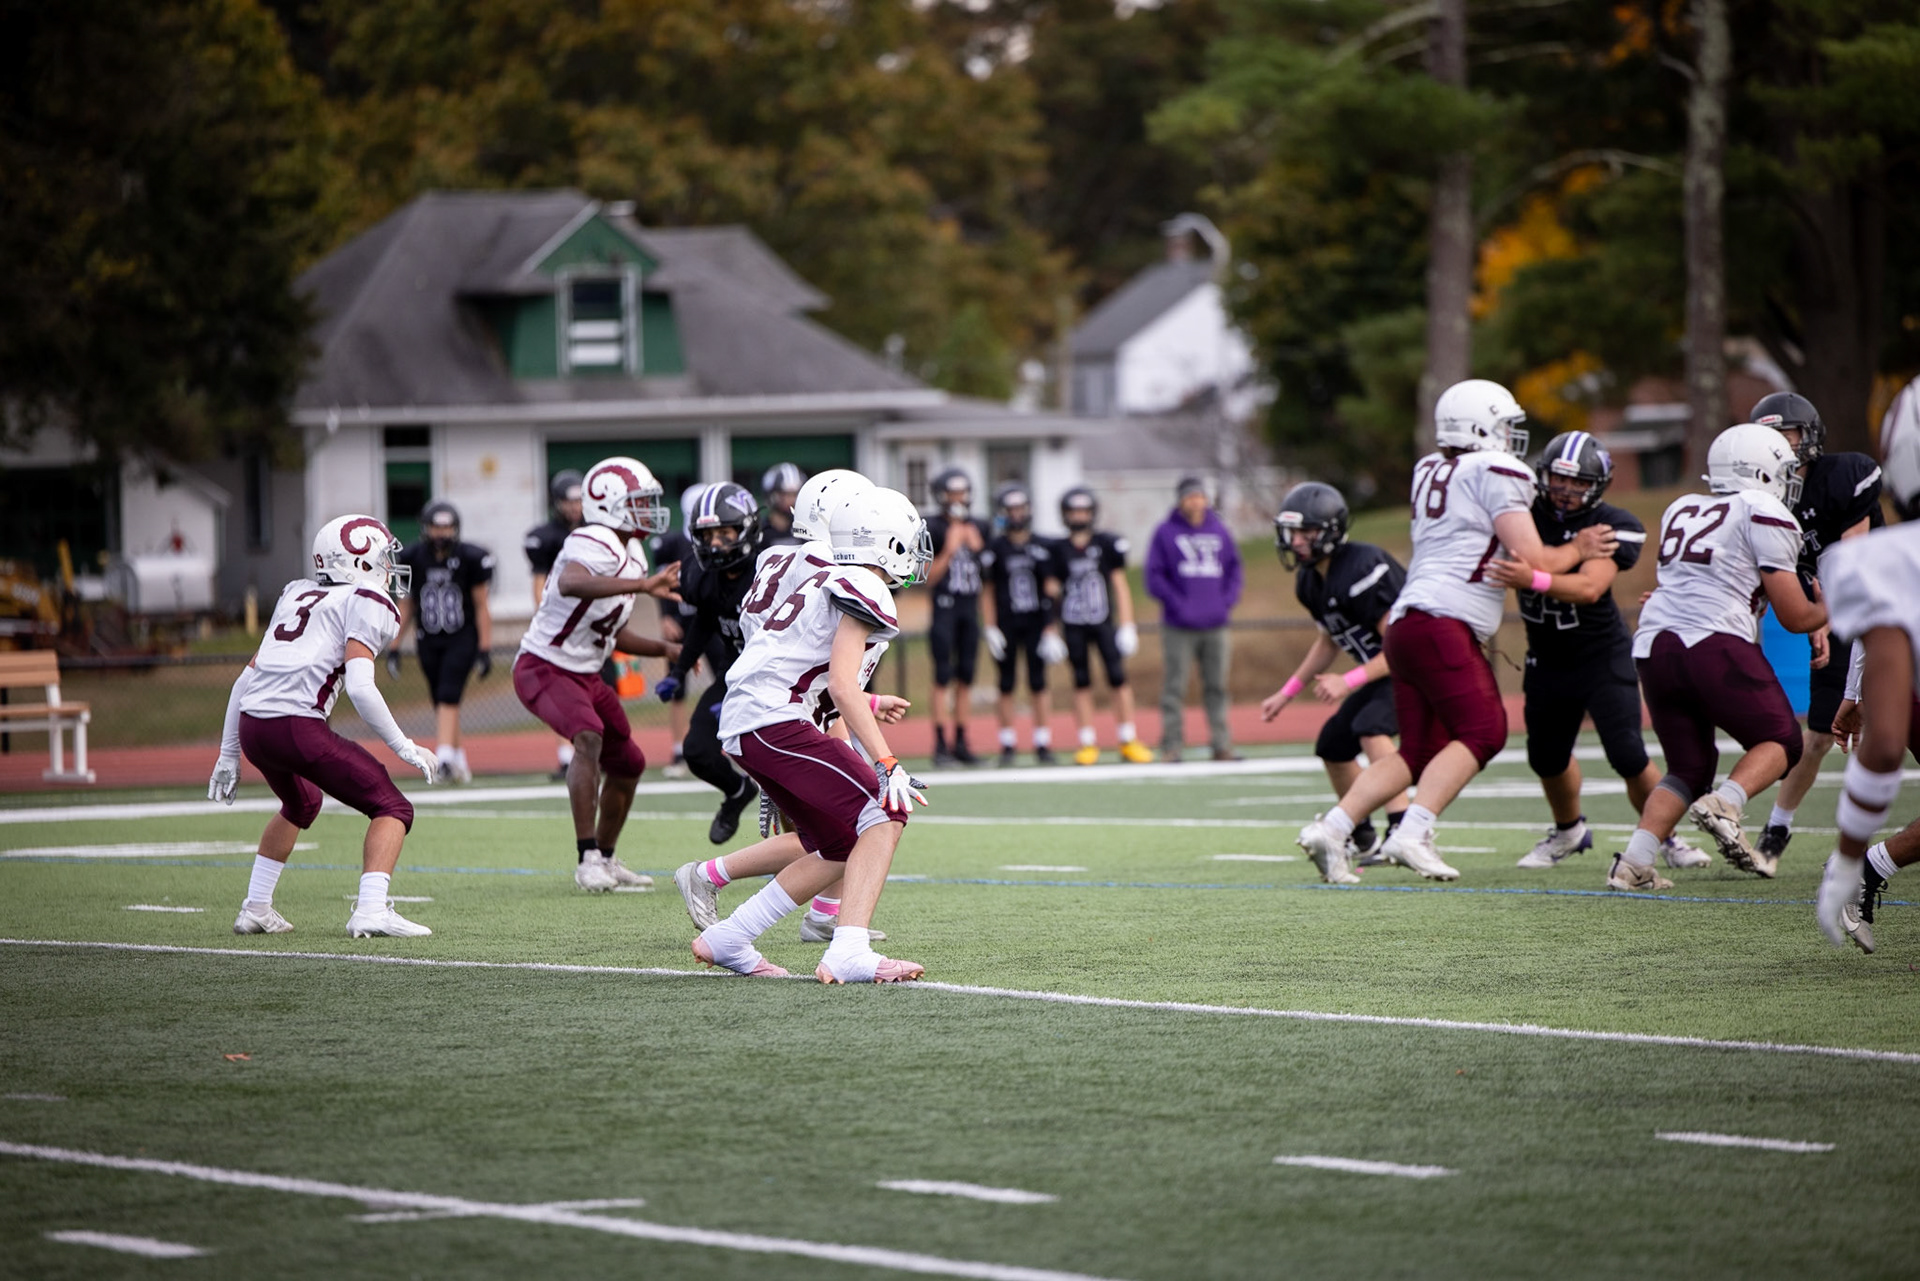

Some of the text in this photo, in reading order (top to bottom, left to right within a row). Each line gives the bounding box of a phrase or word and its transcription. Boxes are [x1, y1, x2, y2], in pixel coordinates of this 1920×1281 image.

[1658, 503, 1731, 567] 62
[274, 590, 329, 642] 3
[420, 583, 465, 634] 88
